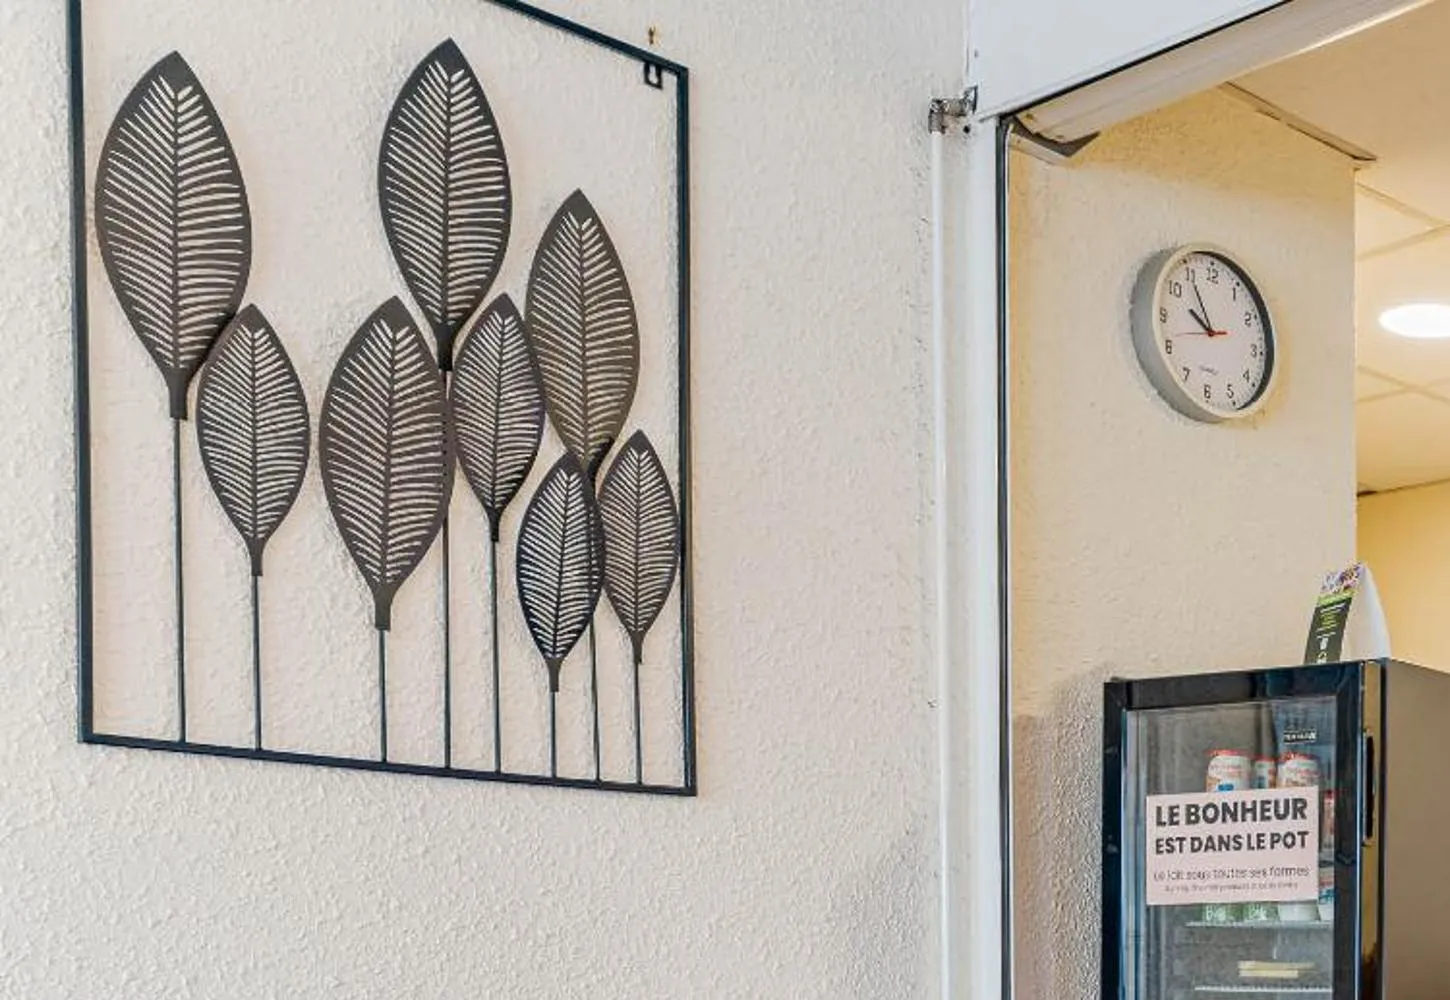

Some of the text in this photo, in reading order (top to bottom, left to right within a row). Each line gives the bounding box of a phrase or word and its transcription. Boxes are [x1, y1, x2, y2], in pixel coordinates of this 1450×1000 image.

[1185, 266, 1196, 284] 11
[1206, 268, 1219, 285] 12
[1168, 280, 1182, 298] 10
[1244, 312, 1252, 326] 2
[1250, 344, 1258, 358] 3
[1183, 367, 1190, 381] 7
[1243, 369, 1250, 382] 4
[1226, 384, 1234, 399] 5
[1155, 798, 1308, 827] LE BONHEUR
[1155, 830, 1310, 855] EST DANS LE POT
